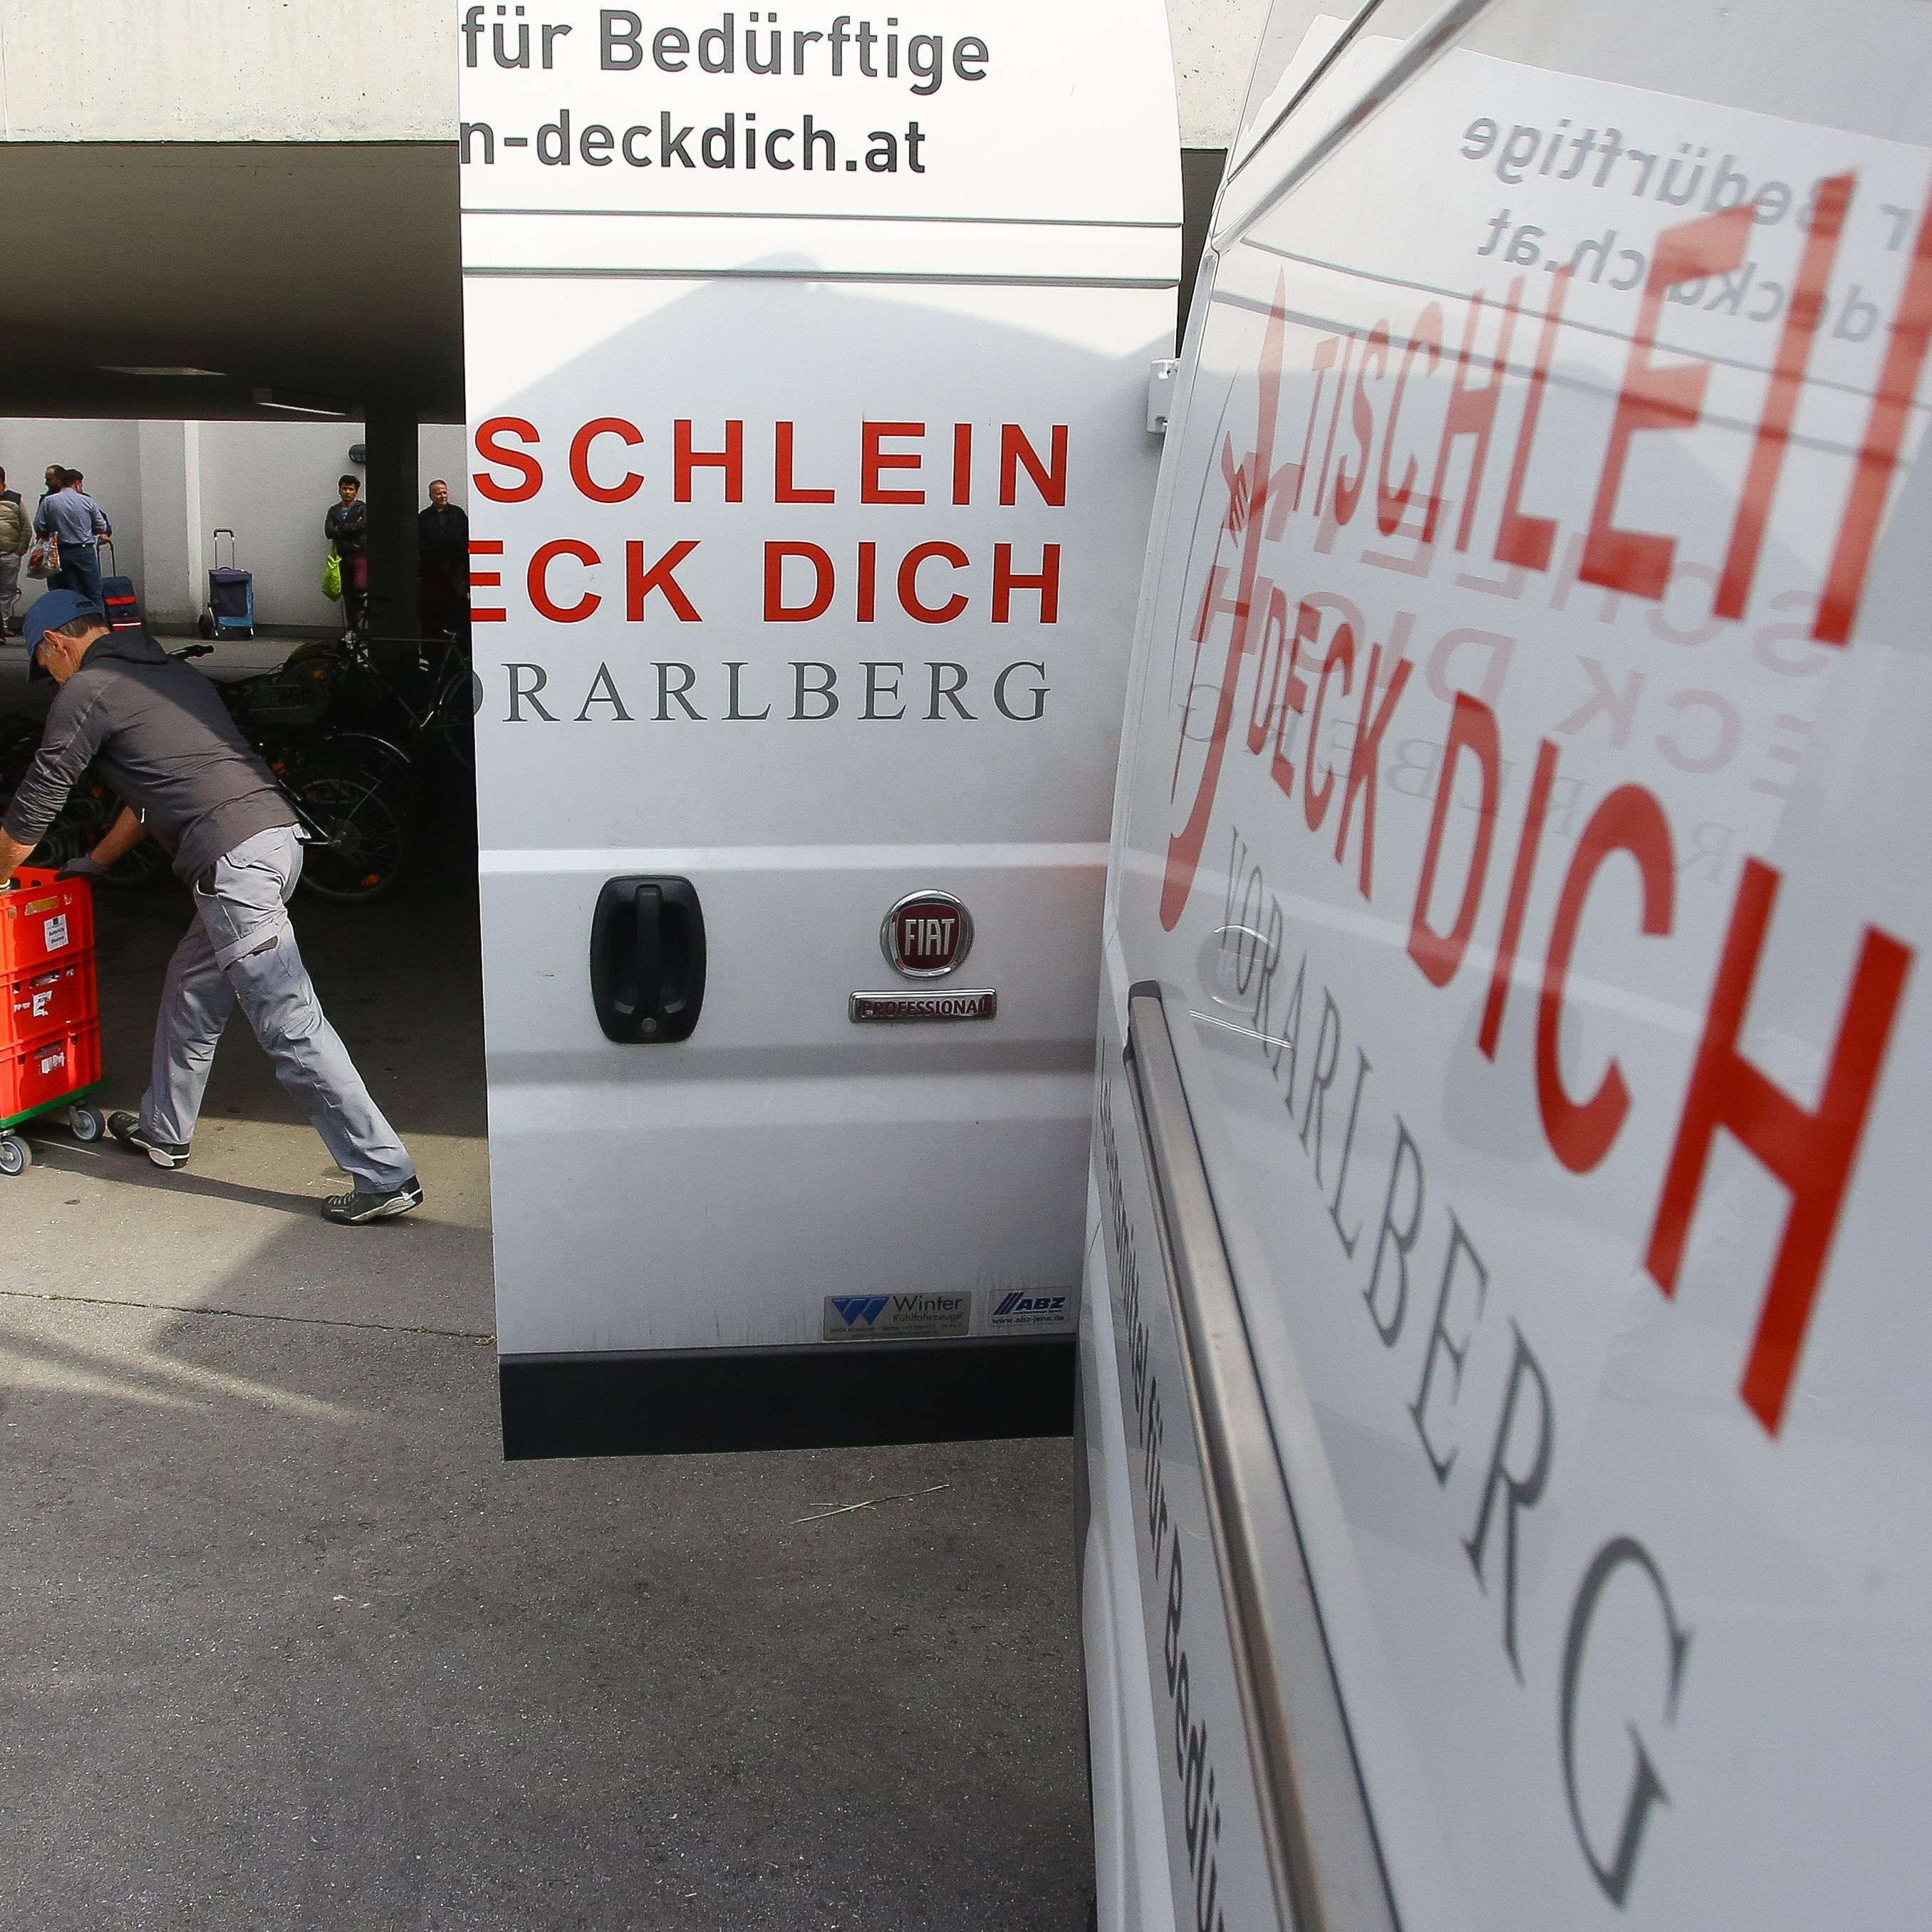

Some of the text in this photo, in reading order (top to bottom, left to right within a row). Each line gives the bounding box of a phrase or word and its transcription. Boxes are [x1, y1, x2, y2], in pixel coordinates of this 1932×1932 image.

[461, 4, 990, 96] für Bedürftige
[459, 108, 926, 174] n-deckdich.at
[1293, 165, 1932, 650] TISCHLEI
[472, 415, 1069, 508] SCHLEIN
[763, 541, 1061, 625] DICH
[472, 660, 1051, 723] RARLBERG
[904, 918, 955, 956] FIAT
[859, 999, 988, 1017] PROFESSIONAL
[1246, 586, 1917, 1445] DECK DICH
[892, 1294, 964, 1312] Winter
[992, 1314, 1066, 1325] www.abz-jena.de
[1014, 1295, 1067, 1312] ABZ
[1220, 826, 1695, 1915] VORARLBERG
[1145, 1375, 1169, 1584] für
[1165, 1523, 1225, 1932] Bedü
